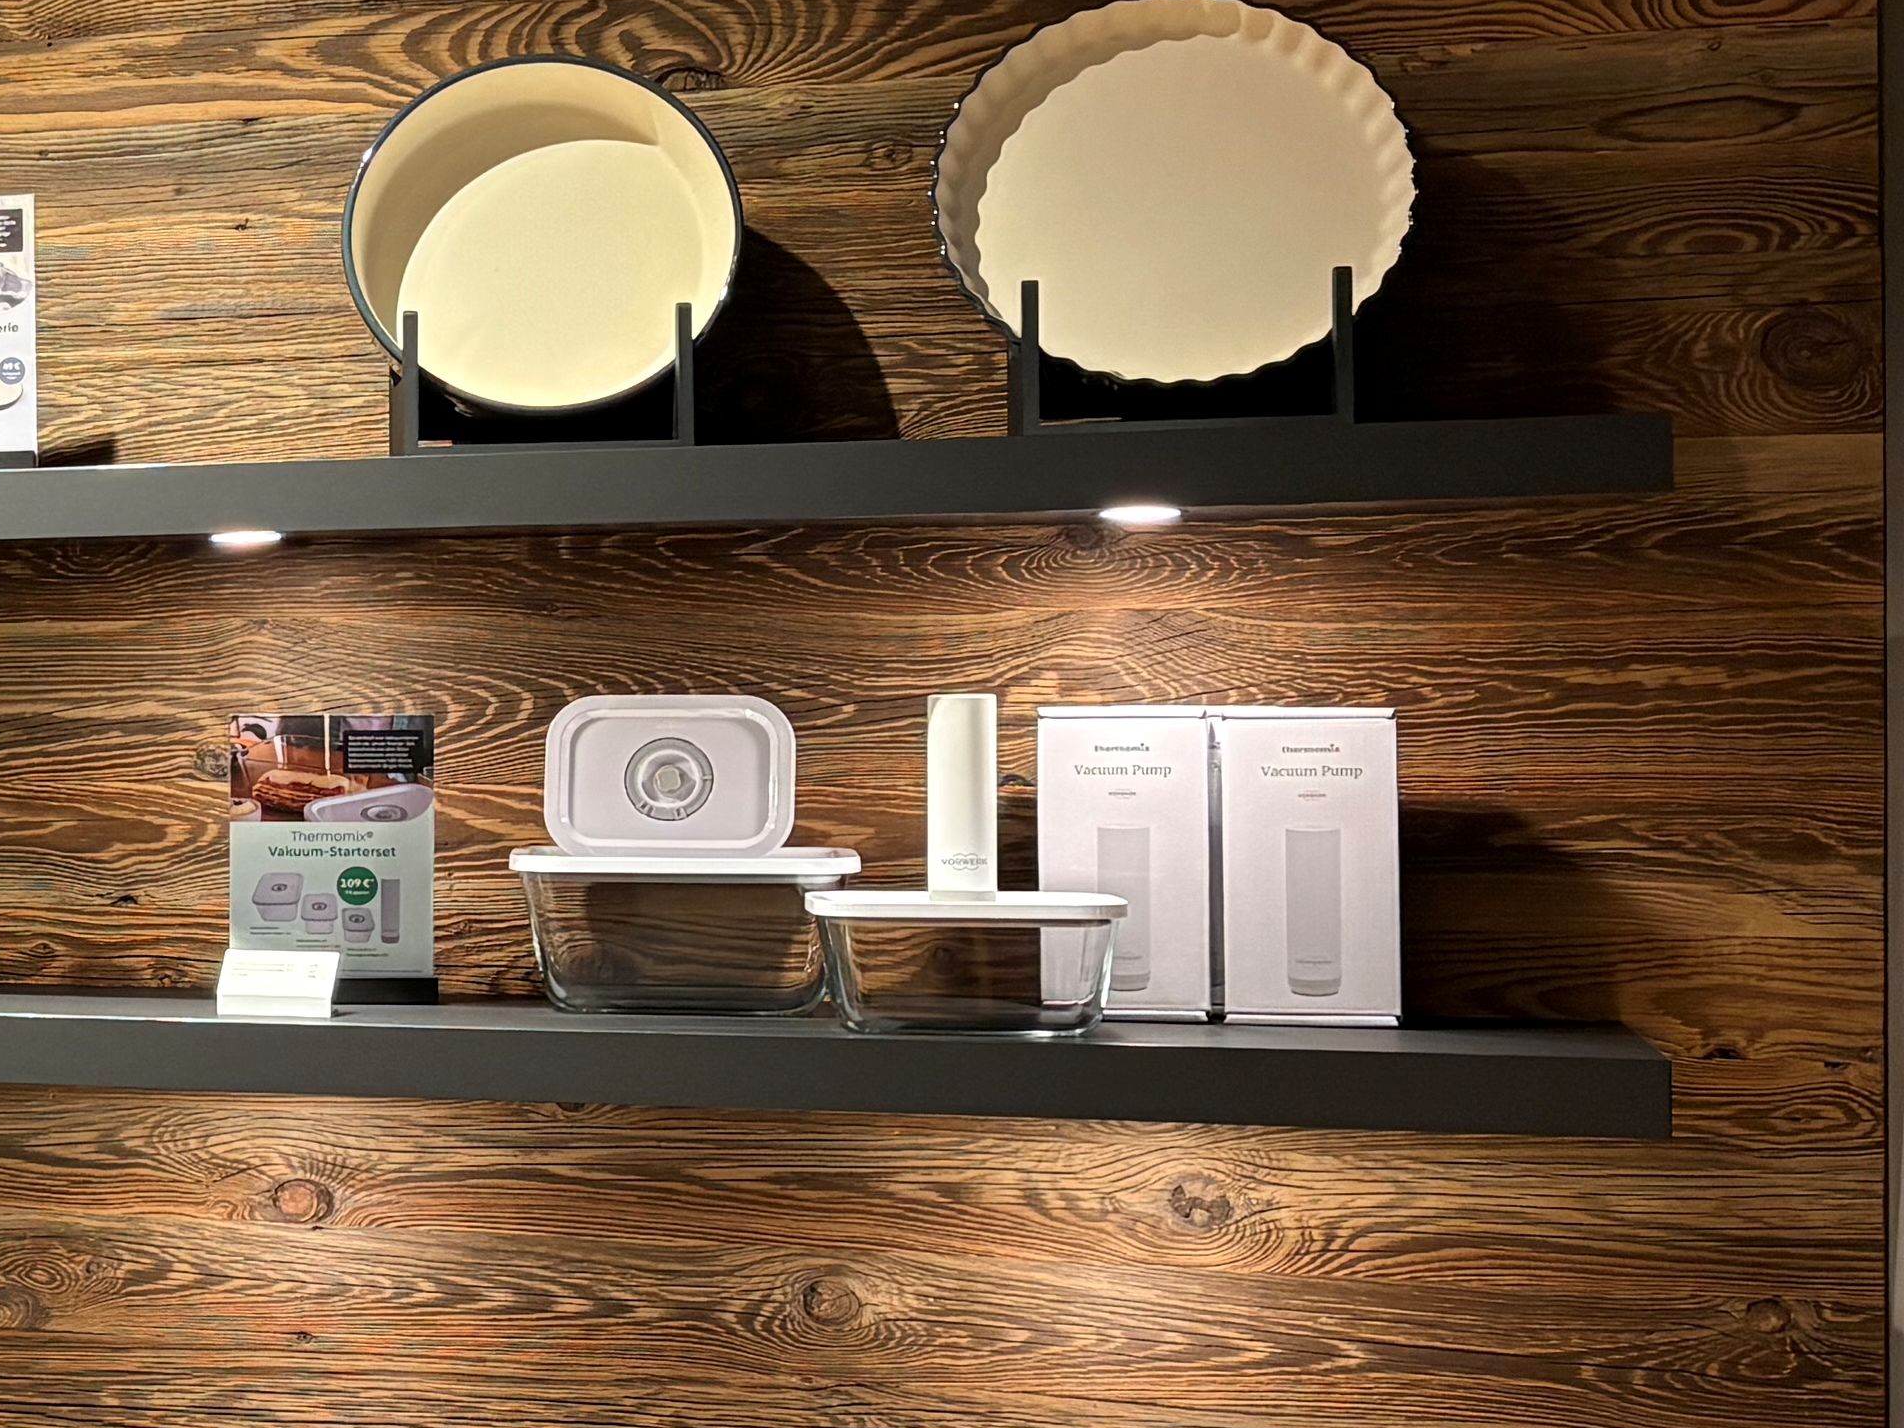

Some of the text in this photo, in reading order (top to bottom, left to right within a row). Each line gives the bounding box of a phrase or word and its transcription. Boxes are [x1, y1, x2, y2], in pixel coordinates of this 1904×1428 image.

[1073, 764, 1172, 778] Vacuum Pump
[1260, 765, 1364, 780] Vacuum Pump
[291, 830, 373, 843] Thermomix®
[268, 845, 397, 859] Vakuum-Starterset
[340, 878, 361, 889] 109
